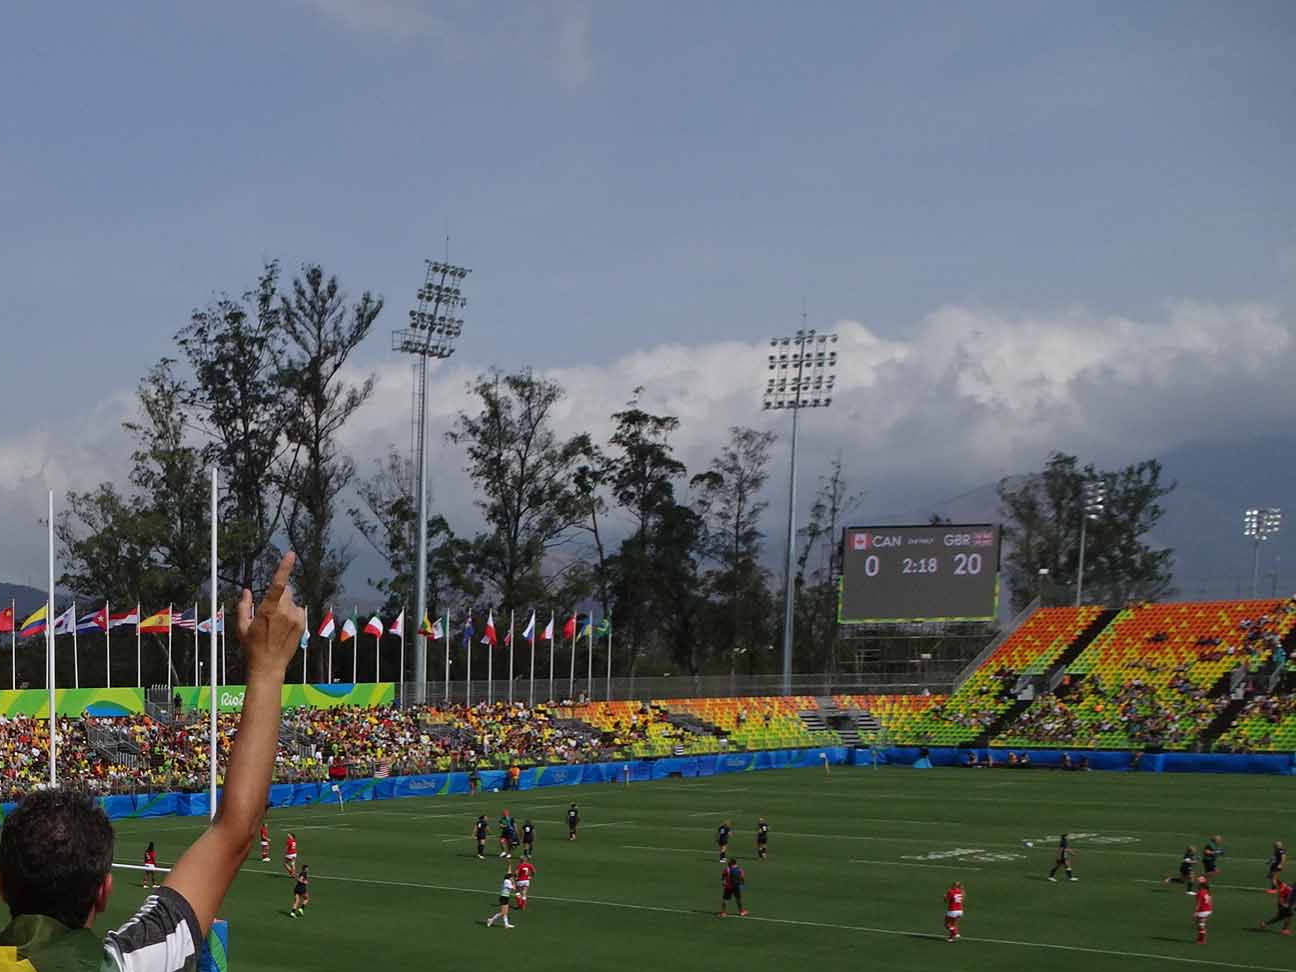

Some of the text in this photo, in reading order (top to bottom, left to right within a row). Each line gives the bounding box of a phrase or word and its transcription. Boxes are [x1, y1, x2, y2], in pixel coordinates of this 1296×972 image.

[872, 535, 902, 548] CAN
[943, 534, 971, 546] GBR
[864, 555, 880, 577] 0
[902, 558, 937, 574] 2:18
[953, 553, 982, 575] 20
